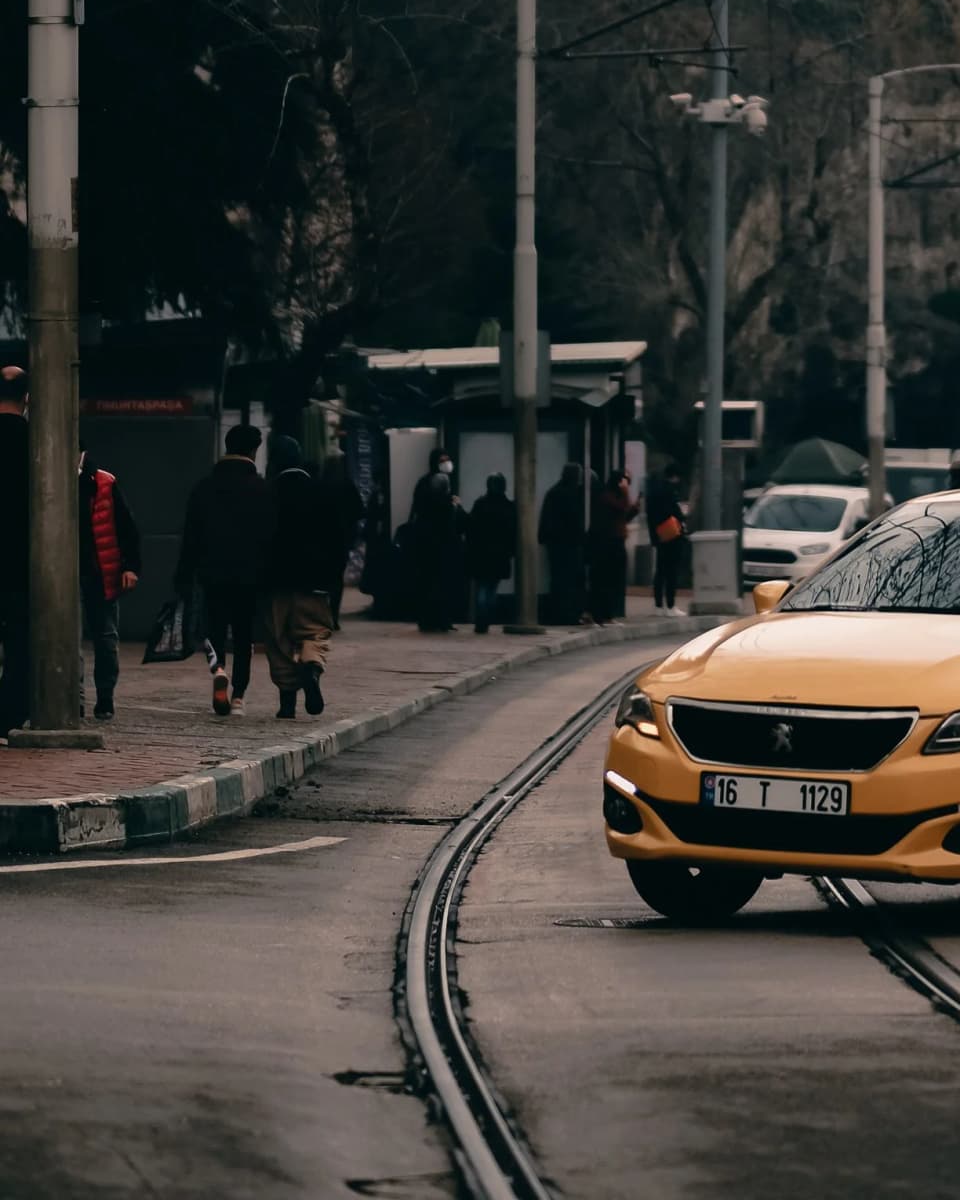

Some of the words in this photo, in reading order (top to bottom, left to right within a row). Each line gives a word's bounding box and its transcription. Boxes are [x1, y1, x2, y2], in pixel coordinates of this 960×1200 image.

[718, 778, 738, 805] 16
[759, 781, 771, 807] T
[800, 784, 843, 813] 1129
